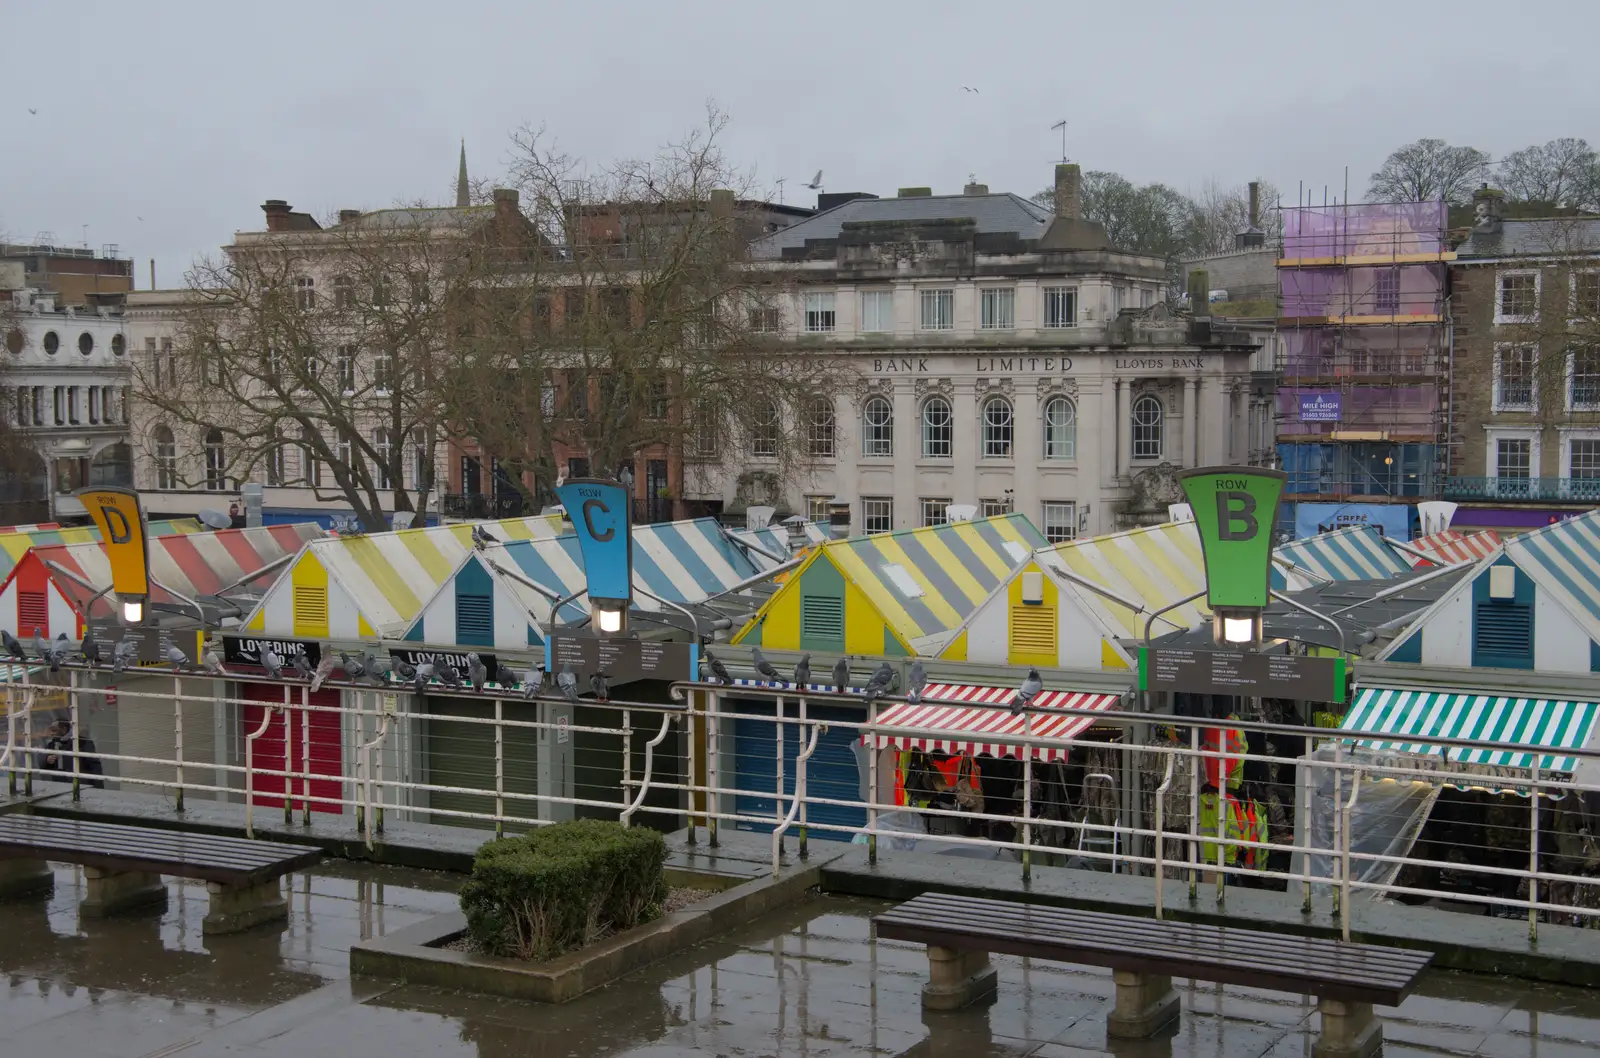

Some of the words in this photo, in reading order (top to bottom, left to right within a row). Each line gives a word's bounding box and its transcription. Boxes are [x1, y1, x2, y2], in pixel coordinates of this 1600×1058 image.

[873, 358, 929, 372] BANK
[976, 357, 1073, 373] LIMITED
[1115, 359, 1164, 369] LLOYDS
[1172, 358, 1204, 369] BANK
[577, 487, 603, 498] ROW
[1216, 479, 1248, 490] ROW
[583, 499, 616, 542] C
[1215, 491, 1258, 542] B
[100, 506, 132, 544] D
